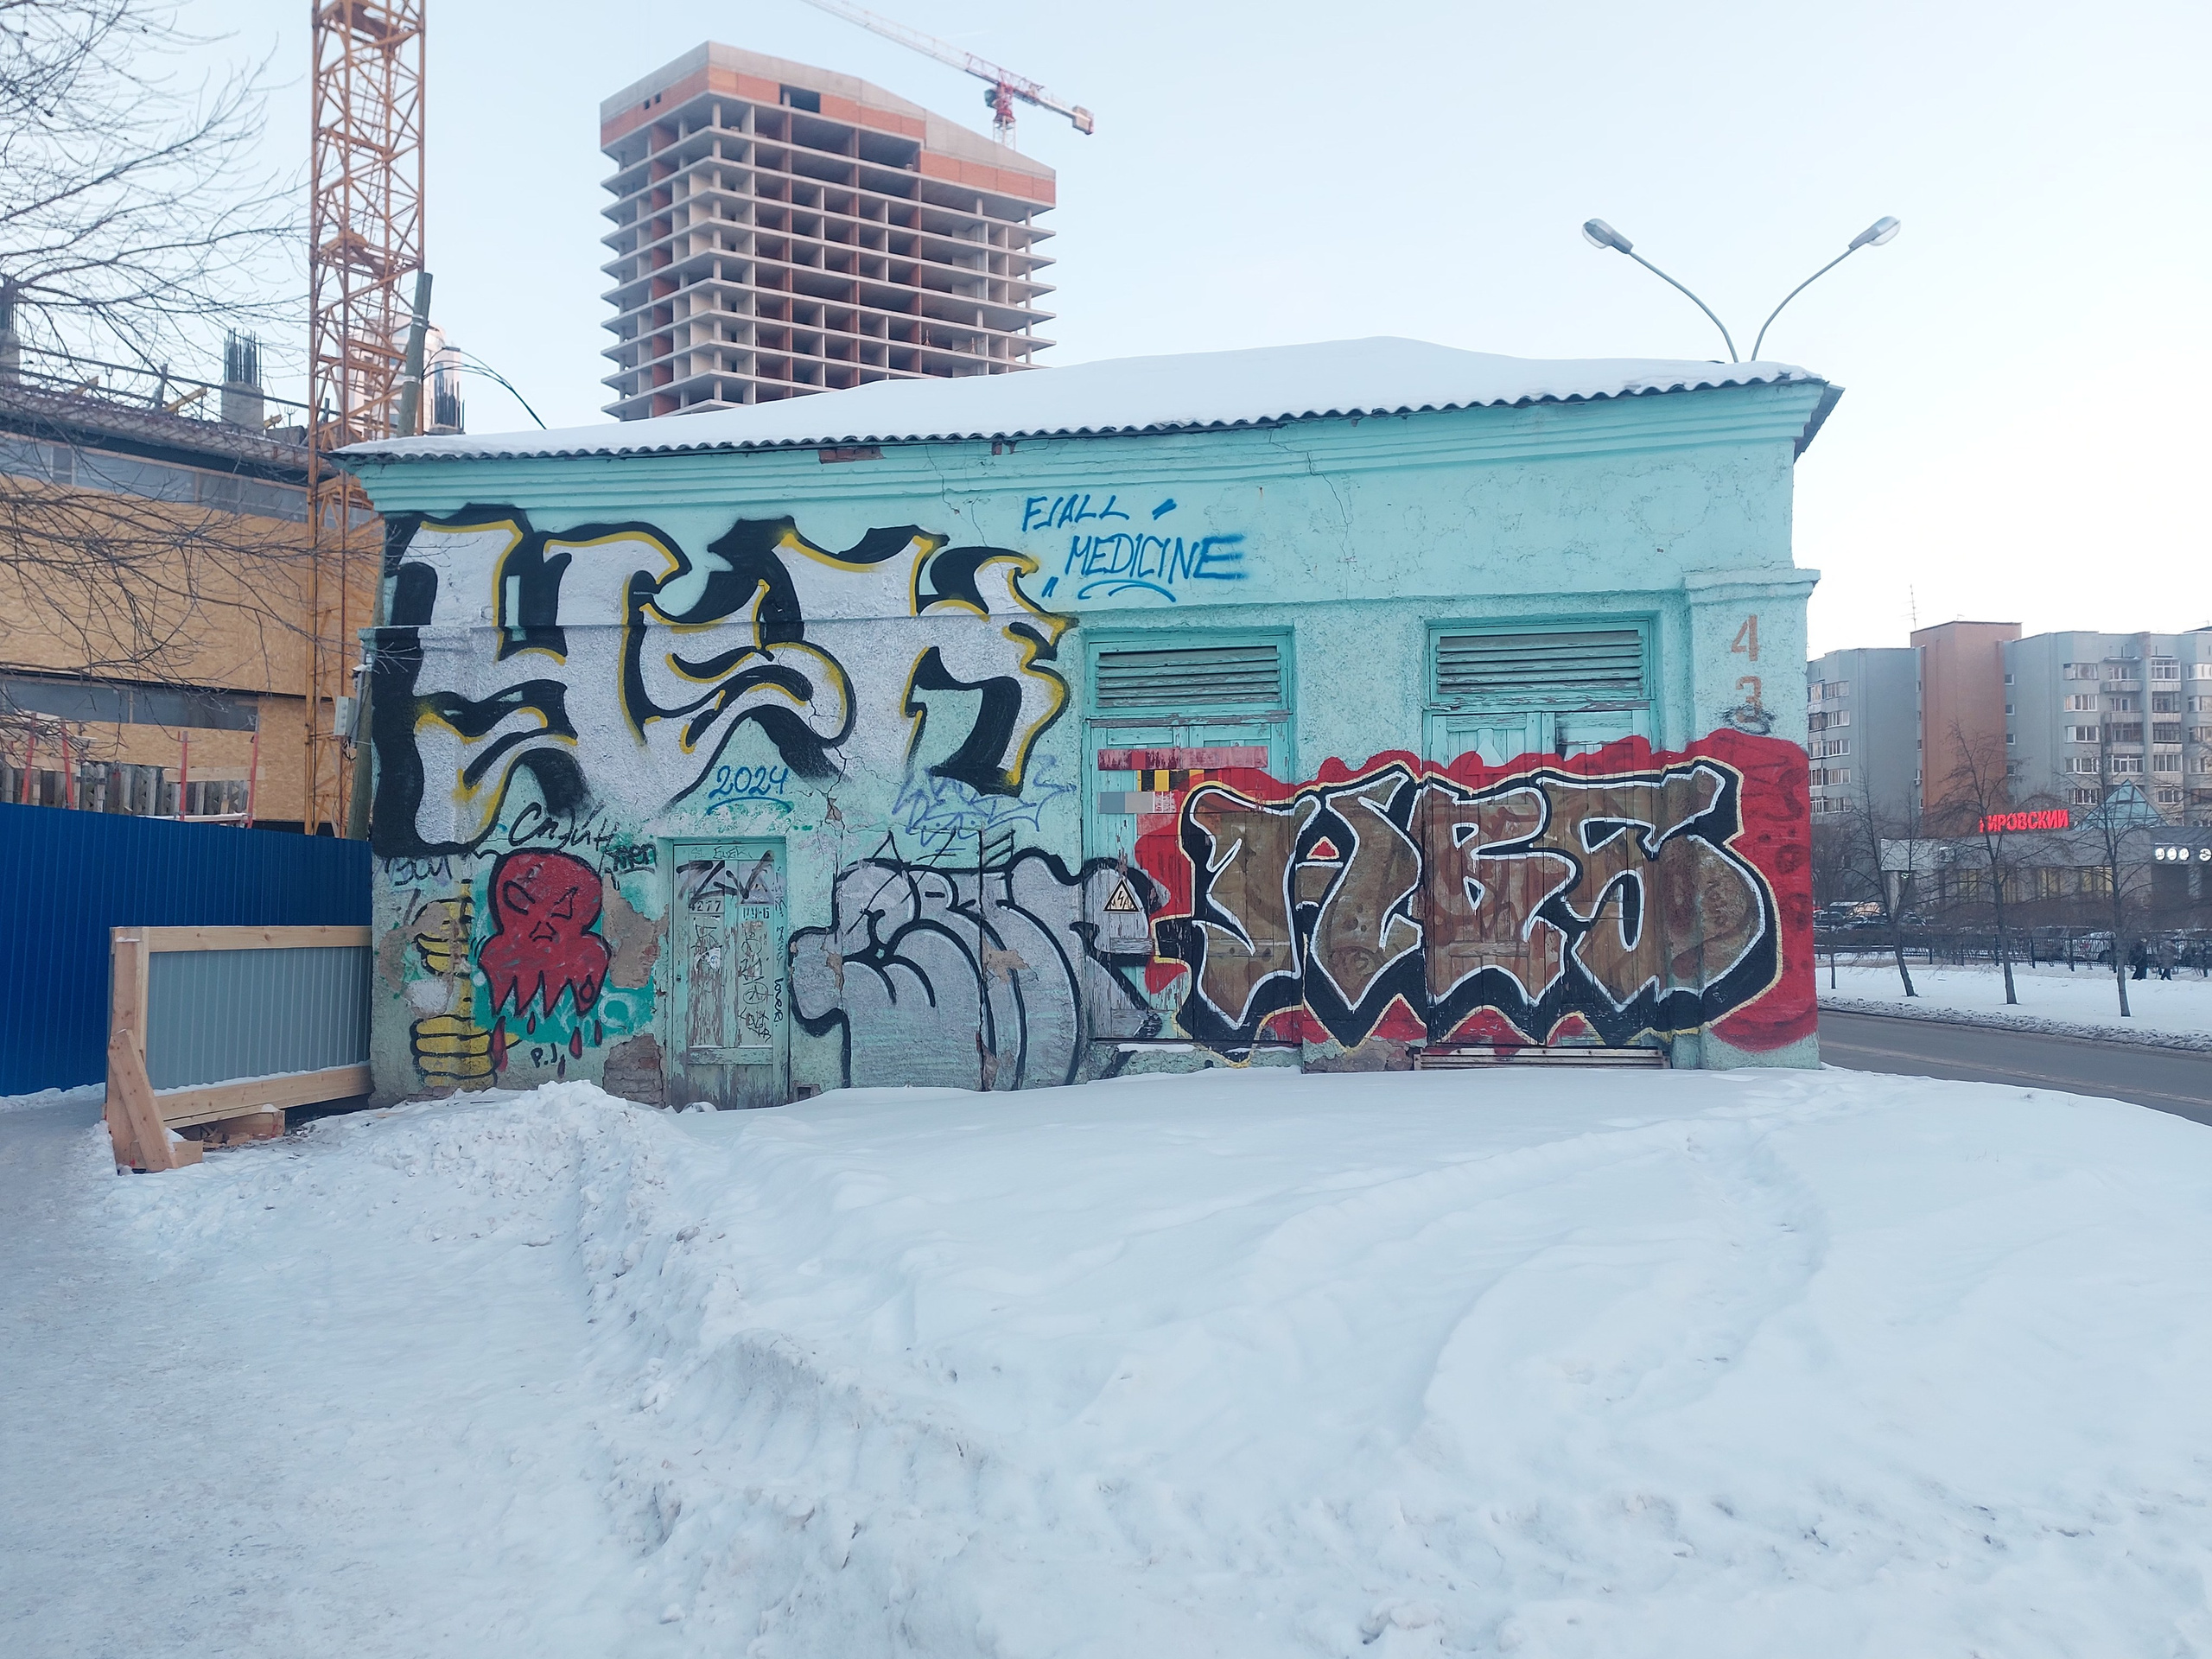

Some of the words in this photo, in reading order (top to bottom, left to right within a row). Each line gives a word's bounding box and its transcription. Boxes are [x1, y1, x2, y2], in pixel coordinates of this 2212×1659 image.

[1065, 530, 1248, 585] MEDICINE
[1731, 613, 1760, 662] 4
[709, 764, 790, 797] 2024
